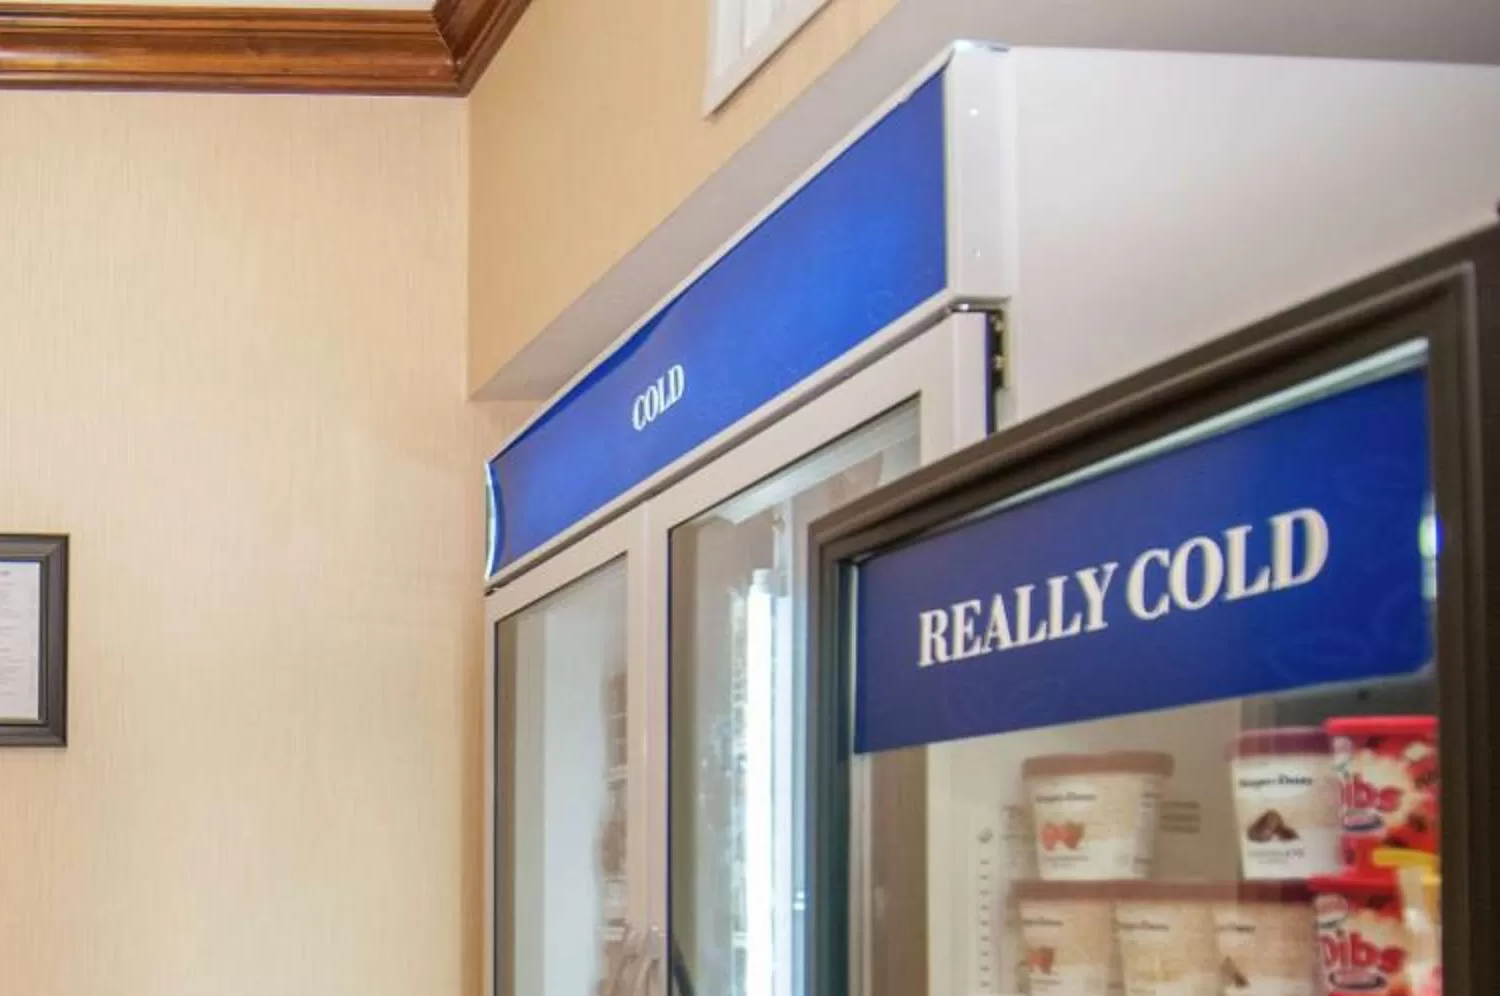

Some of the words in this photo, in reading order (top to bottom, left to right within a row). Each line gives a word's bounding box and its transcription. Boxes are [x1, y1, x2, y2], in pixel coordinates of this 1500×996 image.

[632, 364, 685, 431] COLD
[916, 561, 1120, 669] REALLY
[1126, 507, 1330, 622] COLD
